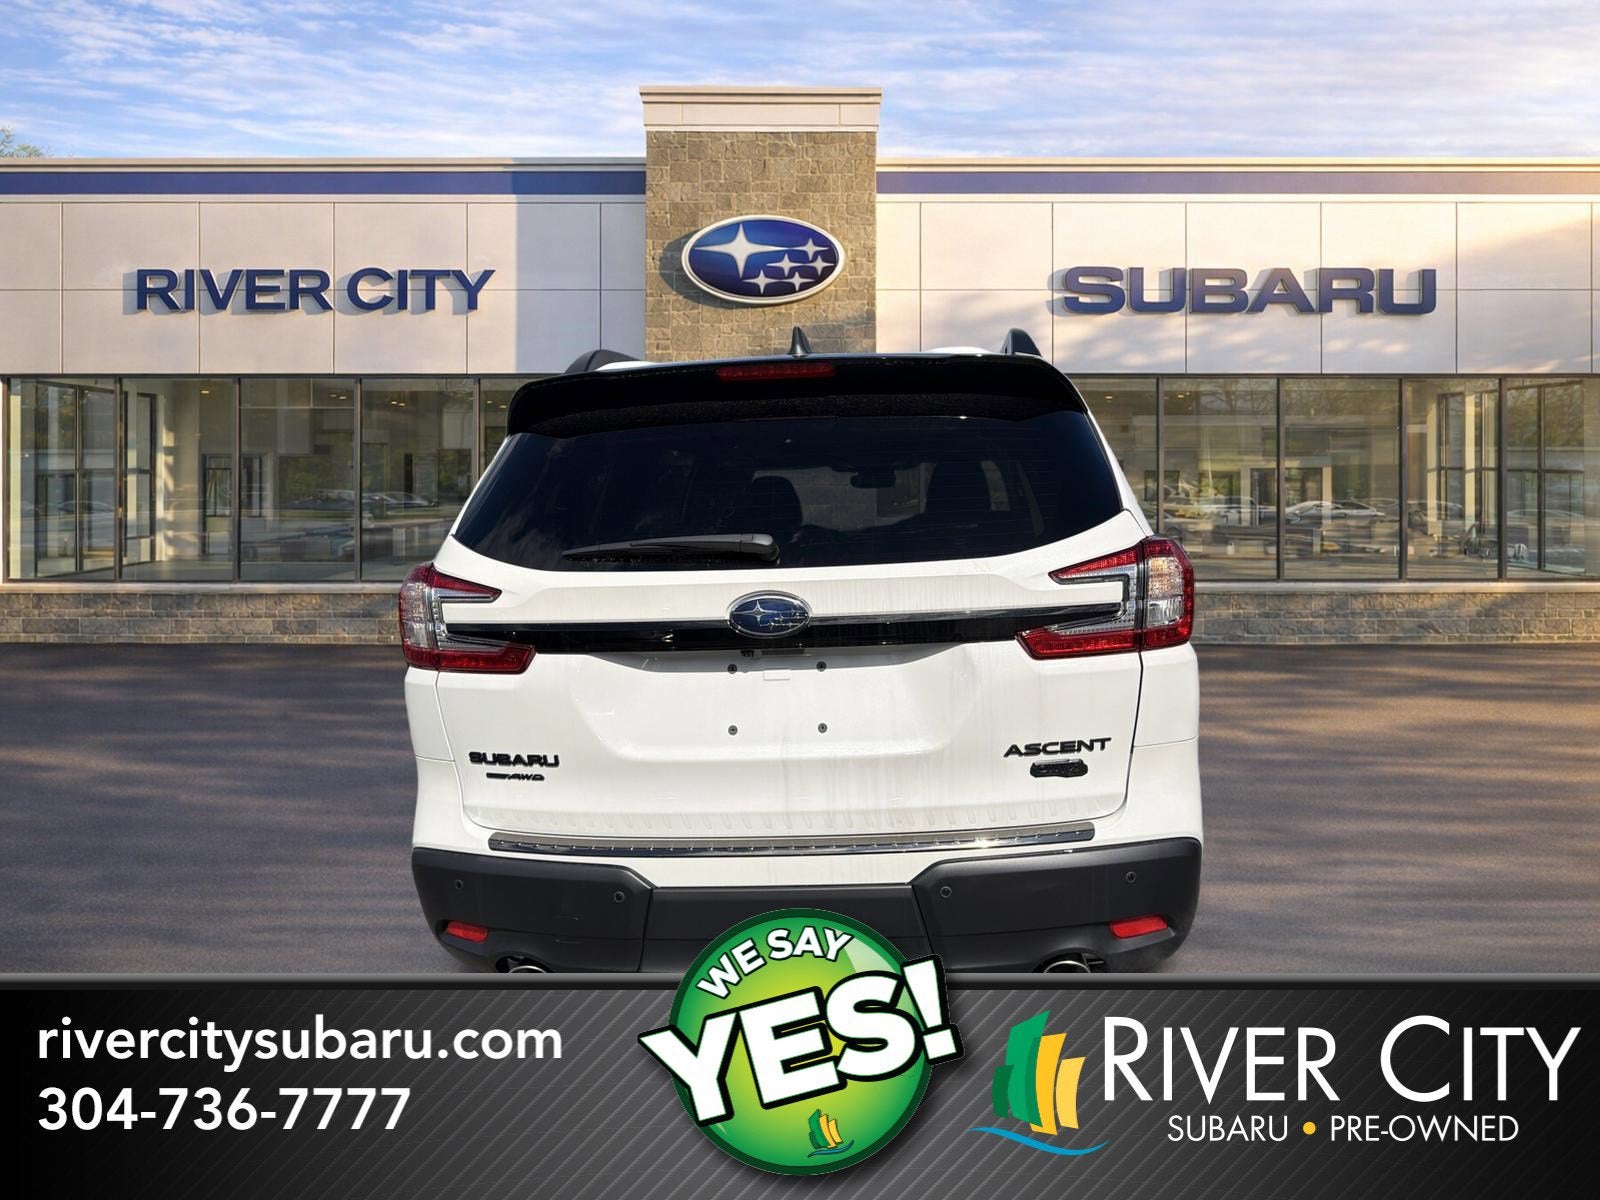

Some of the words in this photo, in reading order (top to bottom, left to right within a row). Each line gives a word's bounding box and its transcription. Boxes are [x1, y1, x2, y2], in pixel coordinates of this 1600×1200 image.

[136, 268, 334, 312] RIVER
[346, 267, 496, 312] CITY
[1063, 266, 1437, 315] SUBARU
[469, 752, 560, 768] SUBARU
[1003, 737, 1112, 758] ASCENT
